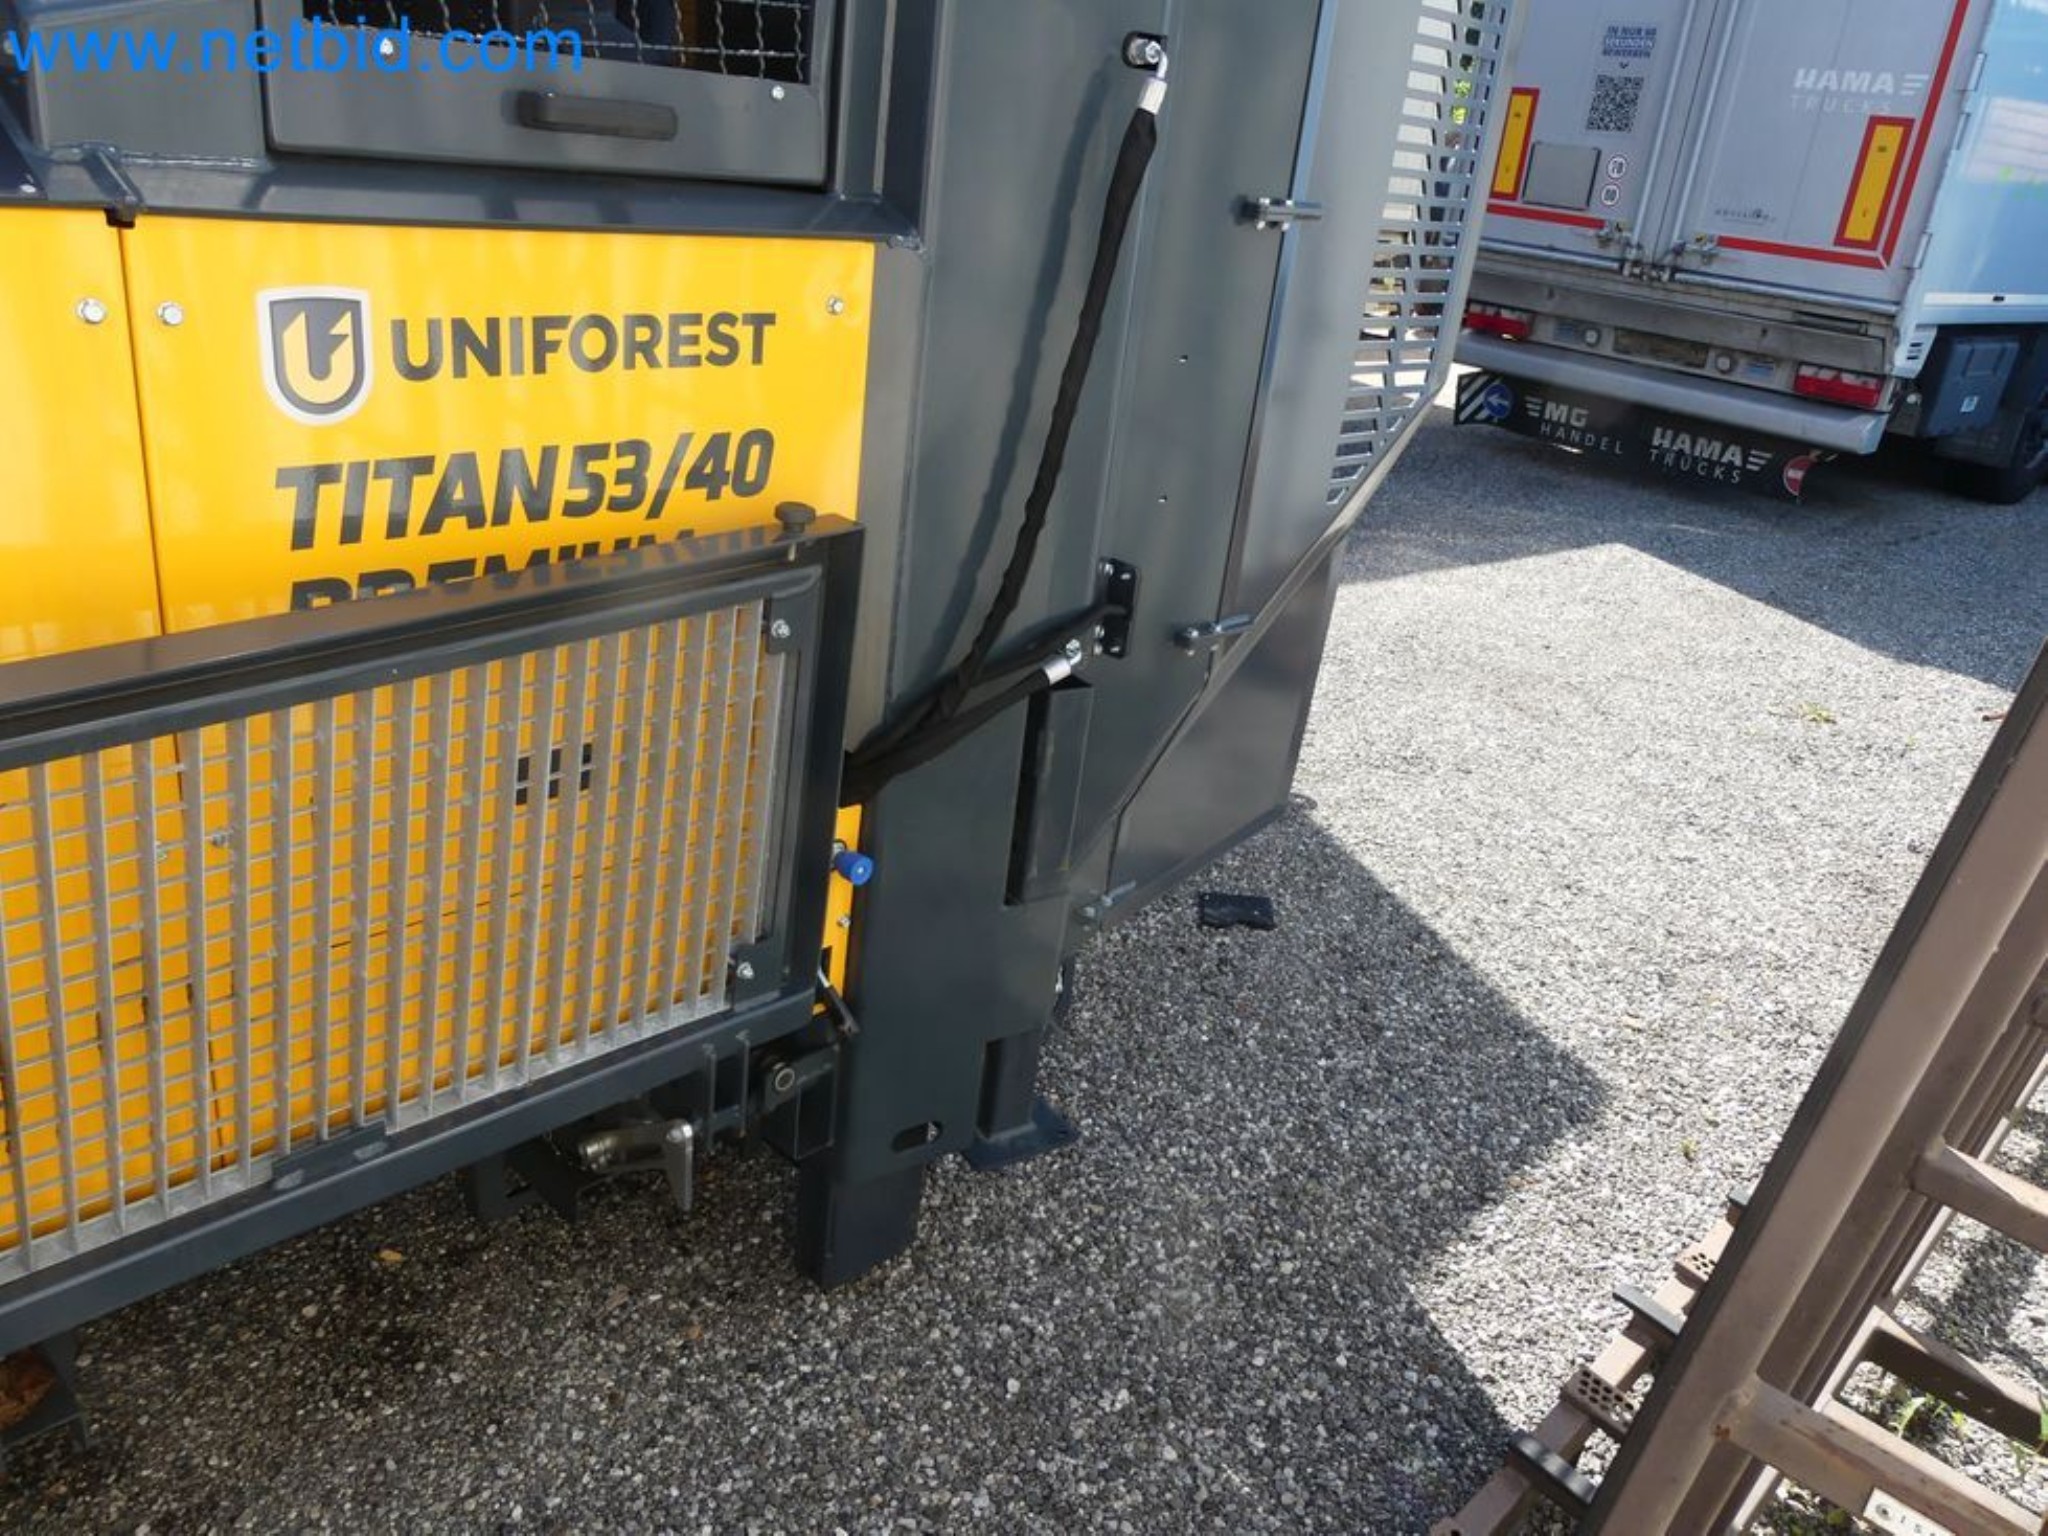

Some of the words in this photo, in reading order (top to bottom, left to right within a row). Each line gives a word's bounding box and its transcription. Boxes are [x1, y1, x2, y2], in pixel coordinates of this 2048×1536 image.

[1794, 68, 1895, 94] HAMA
[391, 312, 776, 382] UNIFOREST
[1543, 400, 1590, 428] MG
[1540, 421, 1623, 455] HANDEL
[1651, 426, 1743, 467] HAMA
[1650, 448, 1741, 484] TRUCKS
